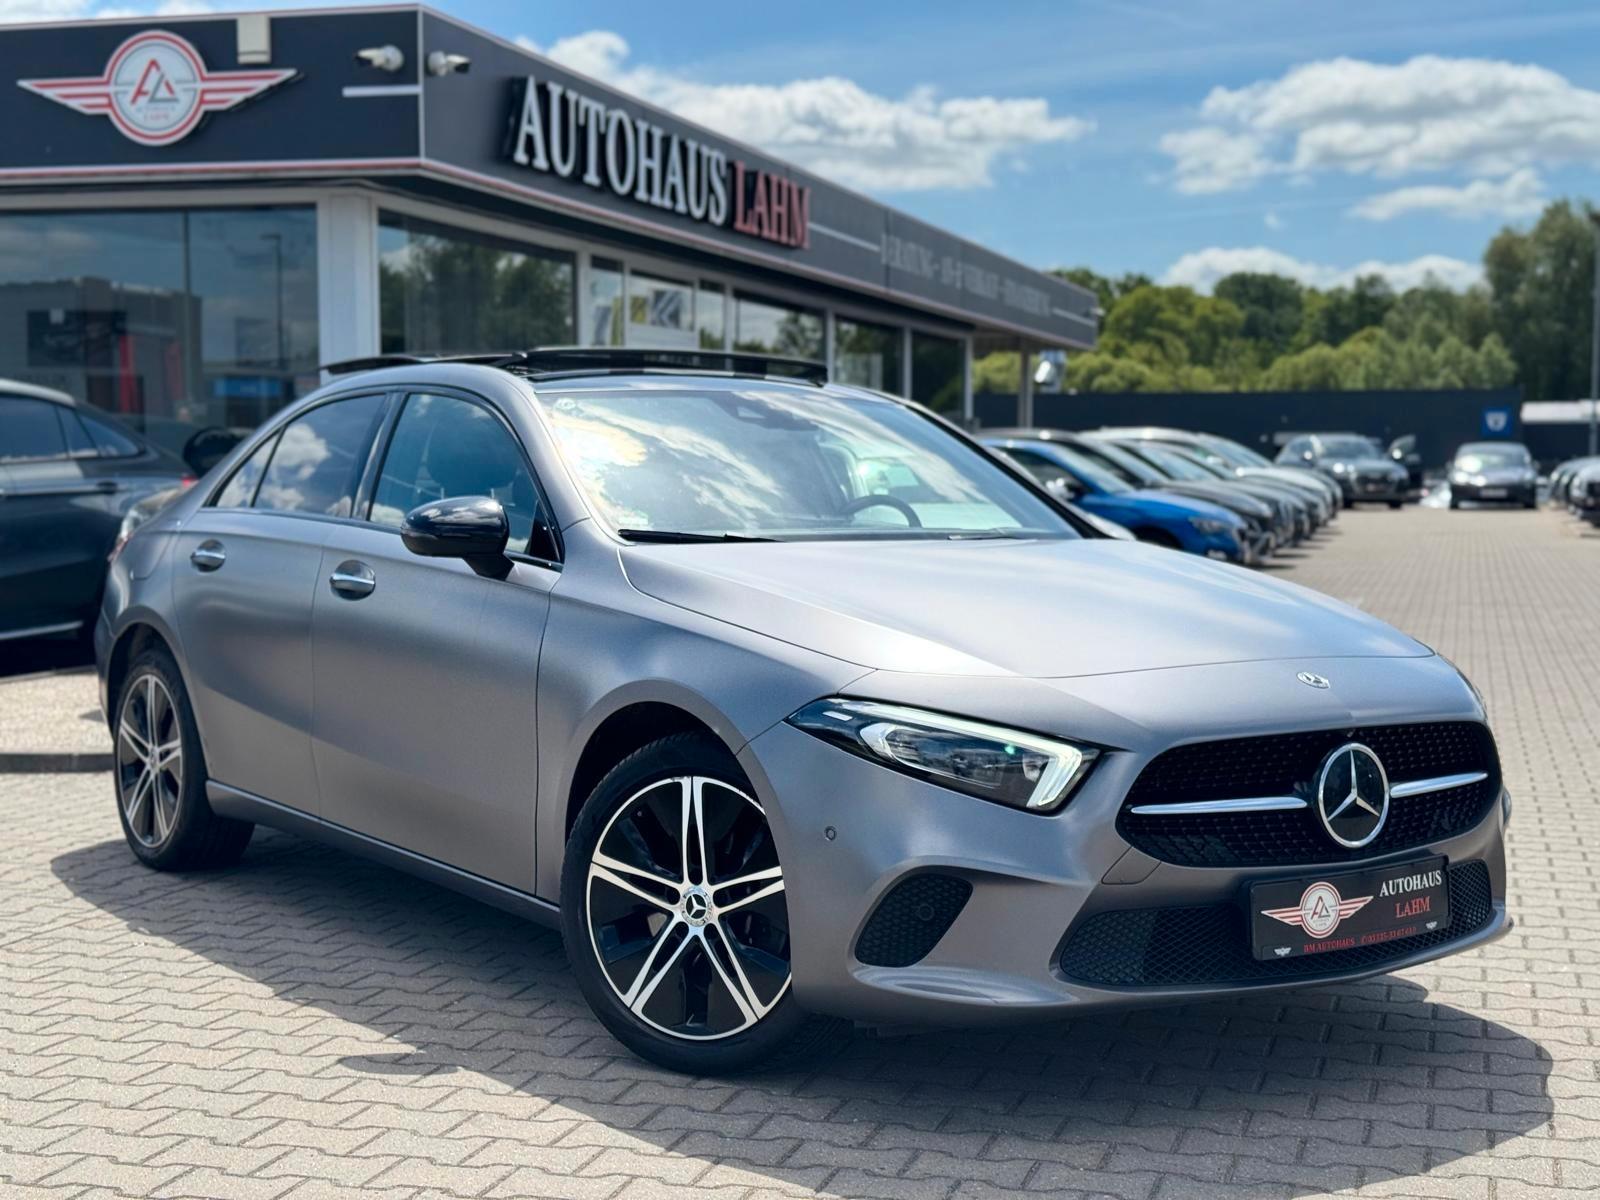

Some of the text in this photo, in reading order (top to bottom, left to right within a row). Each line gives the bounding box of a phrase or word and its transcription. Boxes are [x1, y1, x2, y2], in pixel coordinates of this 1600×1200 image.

[513, 75, 811, 249] AUTOHAUS LAHM
[1379, 870, 1442, 897] AUTOHAUS
[1395, 896, 1431, 918] LAHM
